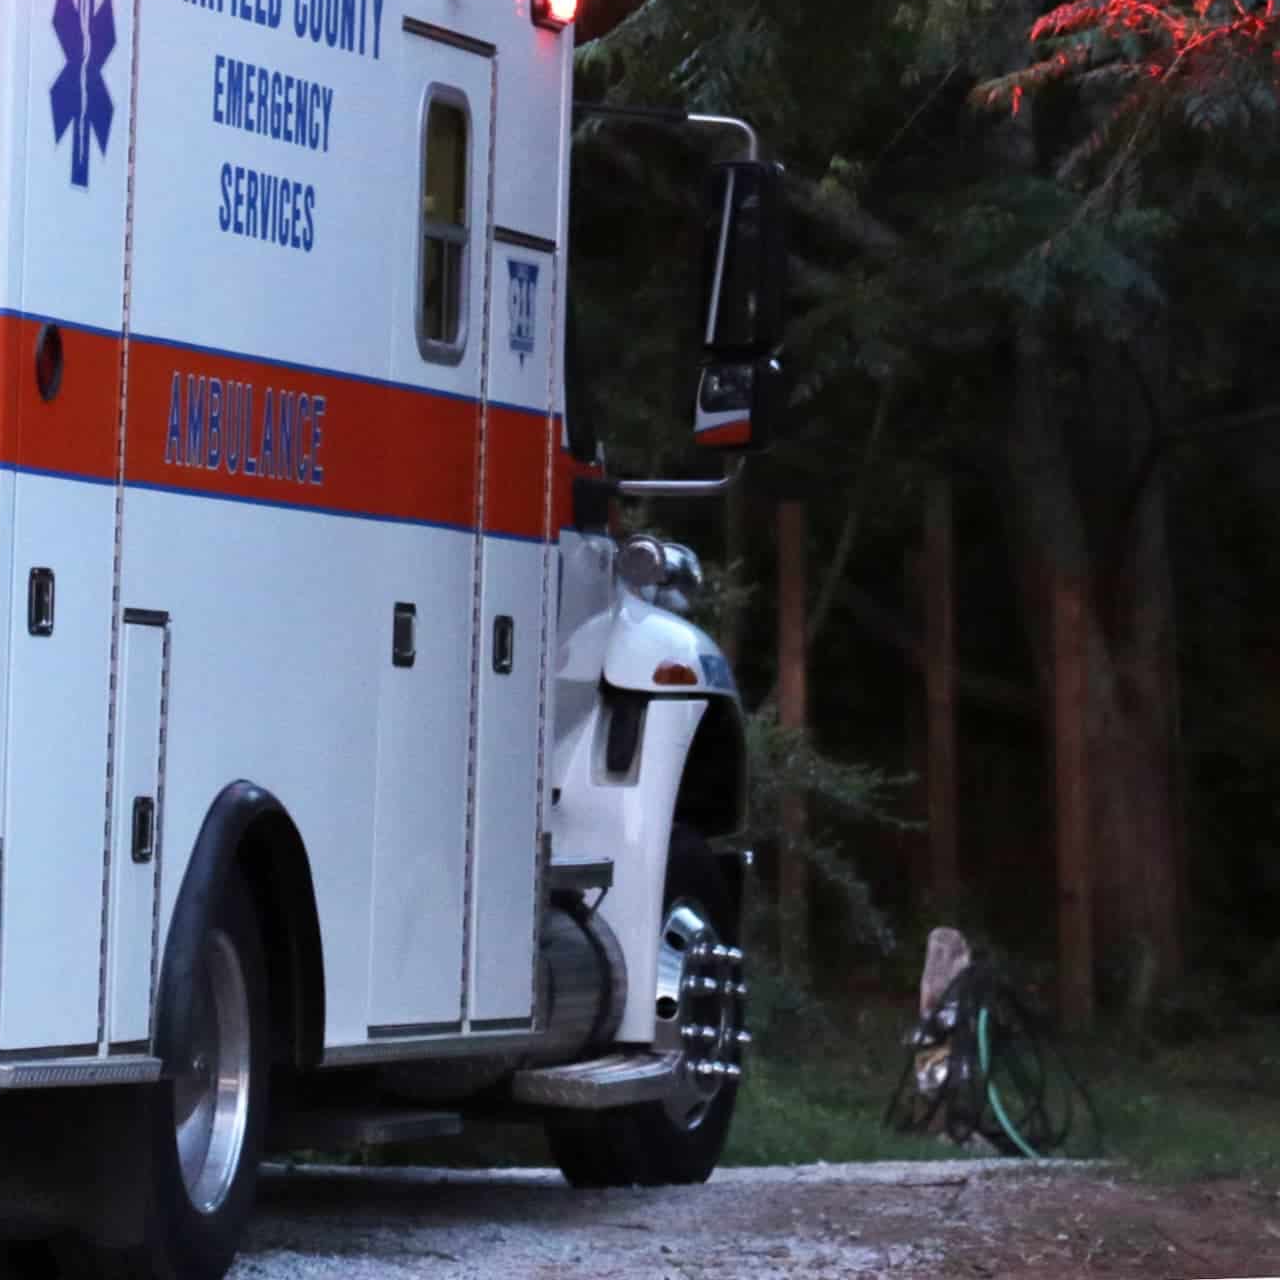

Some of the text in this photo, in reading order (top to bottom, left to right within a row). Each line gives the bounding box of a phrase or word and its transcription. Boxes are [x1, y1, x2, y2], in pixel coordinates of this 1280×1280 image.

[213, 54, 334, 154] EMERGENCY
[219, 162, 316, 253] SERVICES
[164, 370, 327, 487] AMBULANCE
